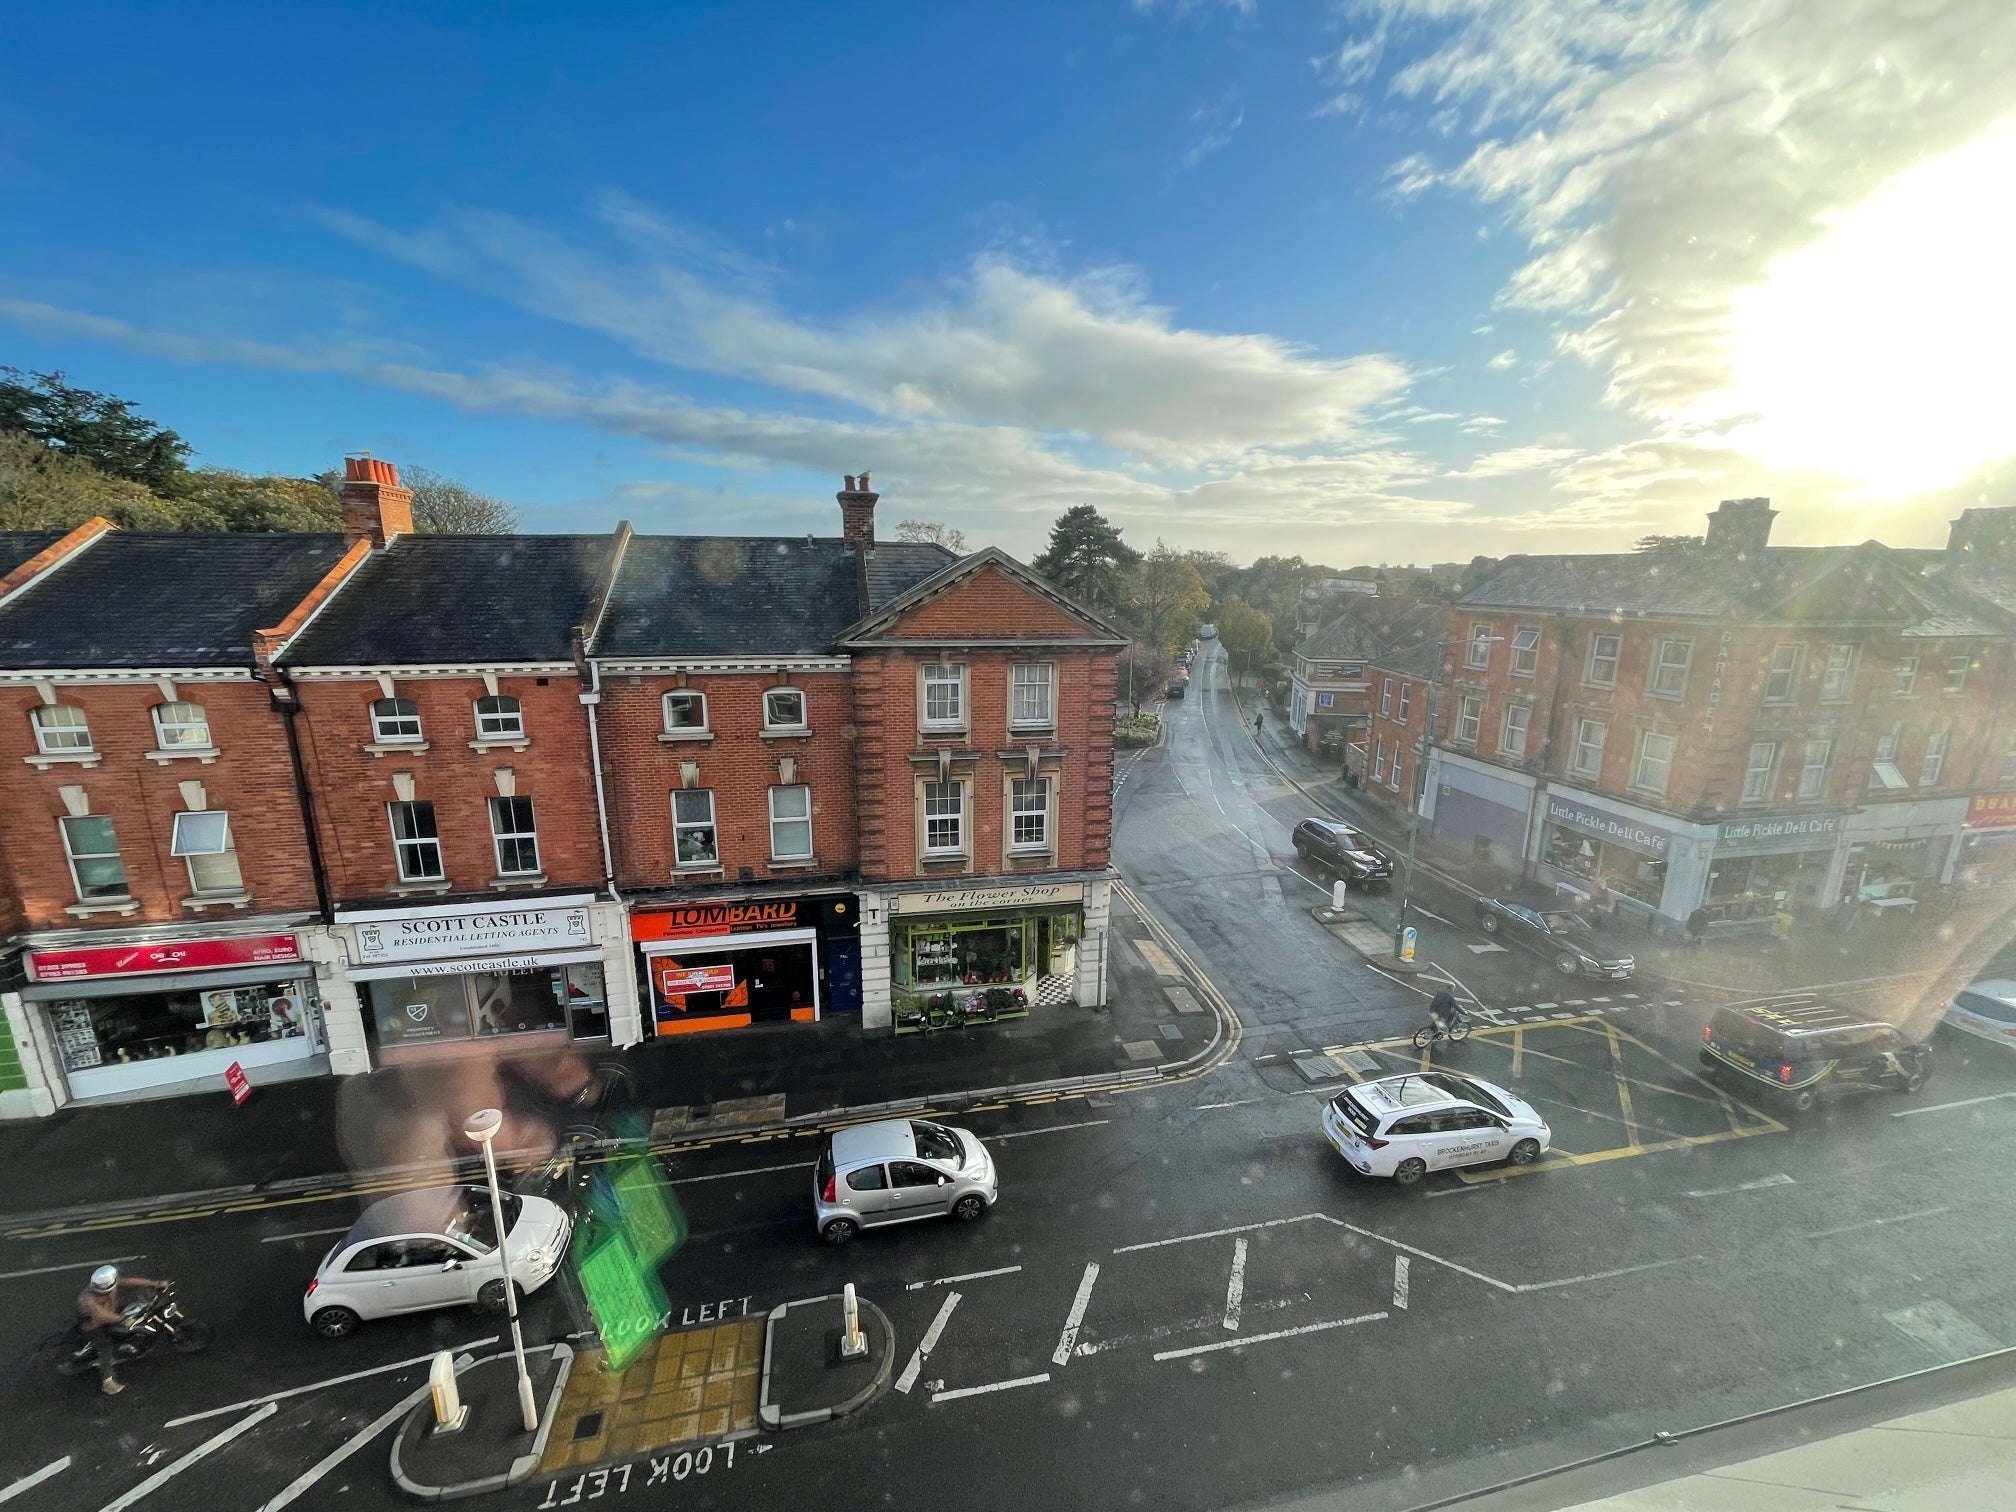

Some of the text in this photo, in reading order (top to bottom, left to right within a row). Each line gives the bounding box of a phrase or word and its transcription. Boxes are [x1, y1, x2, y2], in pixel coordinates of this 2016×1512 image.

[1550, 802, 1666, 850] Little Pickle Deli Café
[1724, 819, 1834, 839] Little Pickle Deli Café
[923, 886, 1060, 903] The Flower Shop
[969, 899, 992, 907] the
[992, 896, 1034, 905] corner
[401, 911, 547, 935] SCOTT CASTLE
[671, 902, 798, 927] LOMBARD
[393, 927, 559, 947] RESIDENTIAL LETTING AGENTS
[730, 924, 753, 933] Laptops
[253, 952, 298, 961] HAIR DESIGN
[410, 956, 538, 976] www.scottcastle.uk
[1437, 1142, 1483, 1155] BROCKENHURST
[1484, 1139, 1500, 1148] TAXIS
[599, 1295, 752, 1341] LOOK LEFT
[536, 1441, 735, 1511] LOOK LEFT
